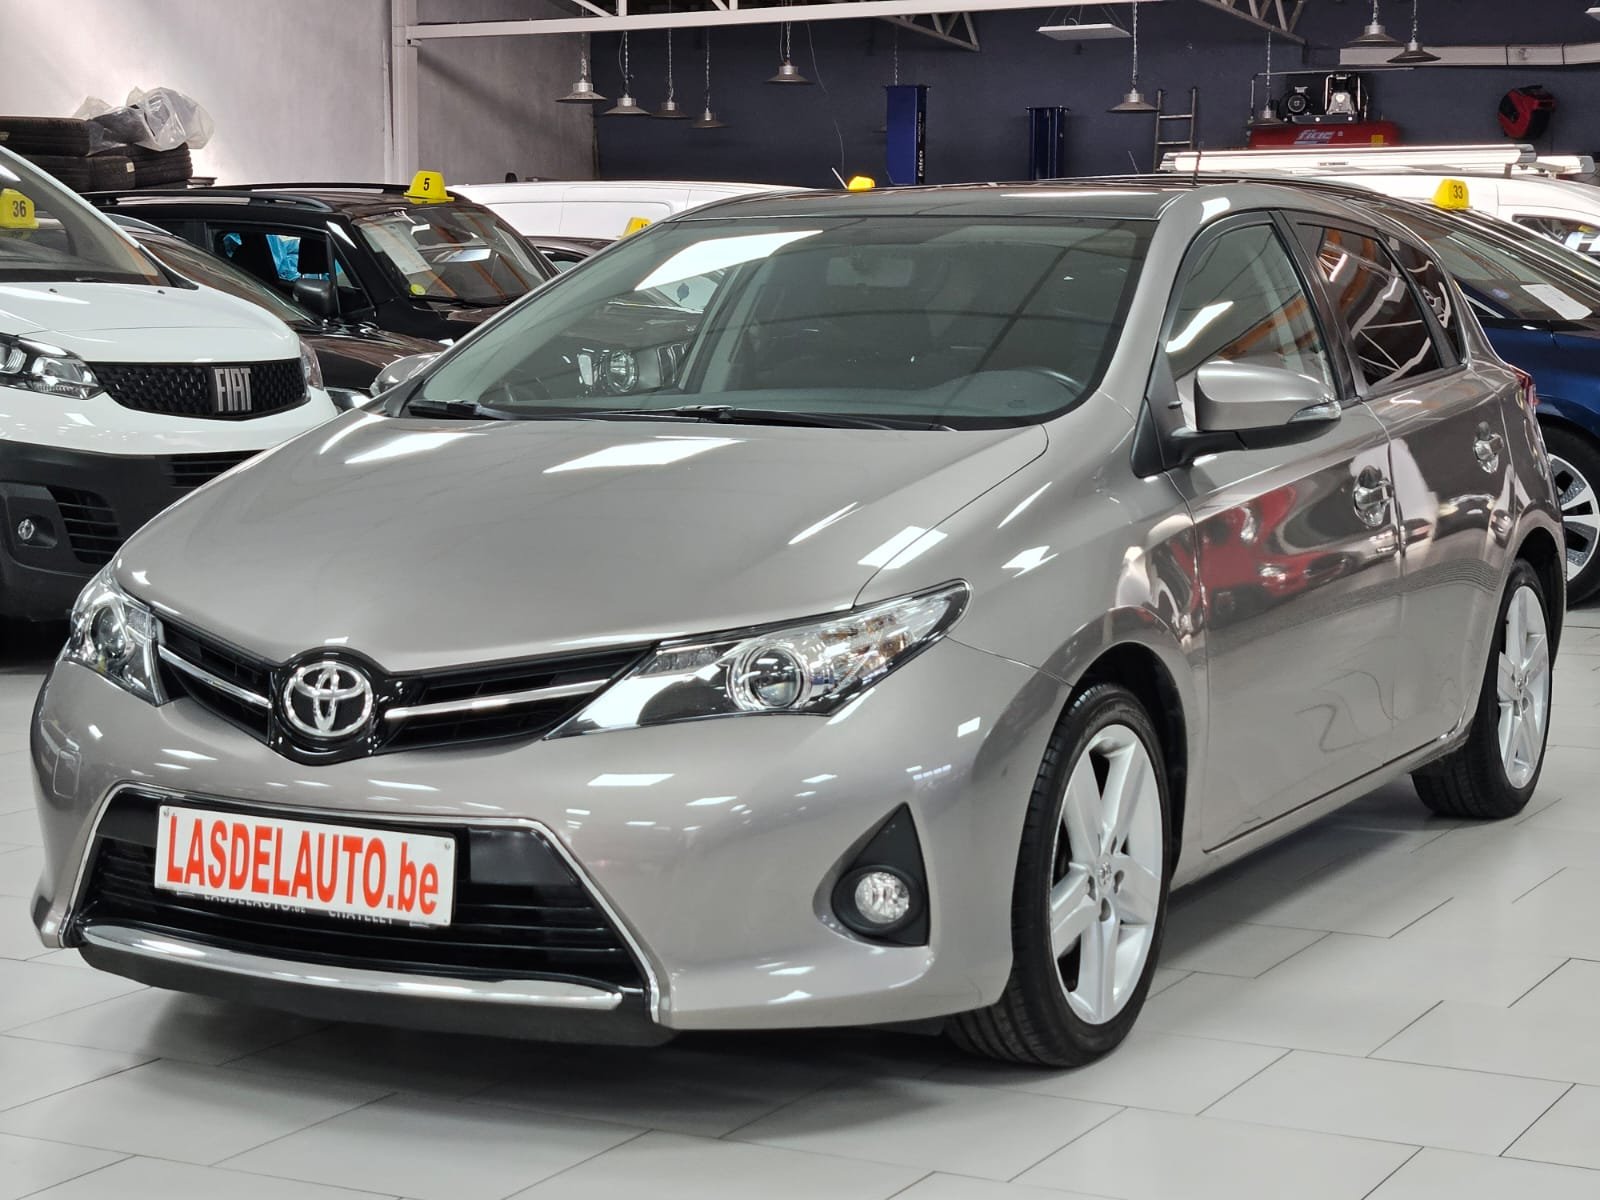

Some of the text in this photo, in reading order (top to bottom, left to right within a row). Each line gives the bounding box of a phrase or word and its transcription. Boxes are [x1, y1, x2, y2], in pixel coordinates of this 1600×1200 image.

[423, 177, 430, 191] 5
[1453, 184, 1464, 200] 33
[12, 200, 27, 218] 36
[214, 367, 252, 412] FIAT
[166, 815, 439, 915] LASDELAUTO.be
